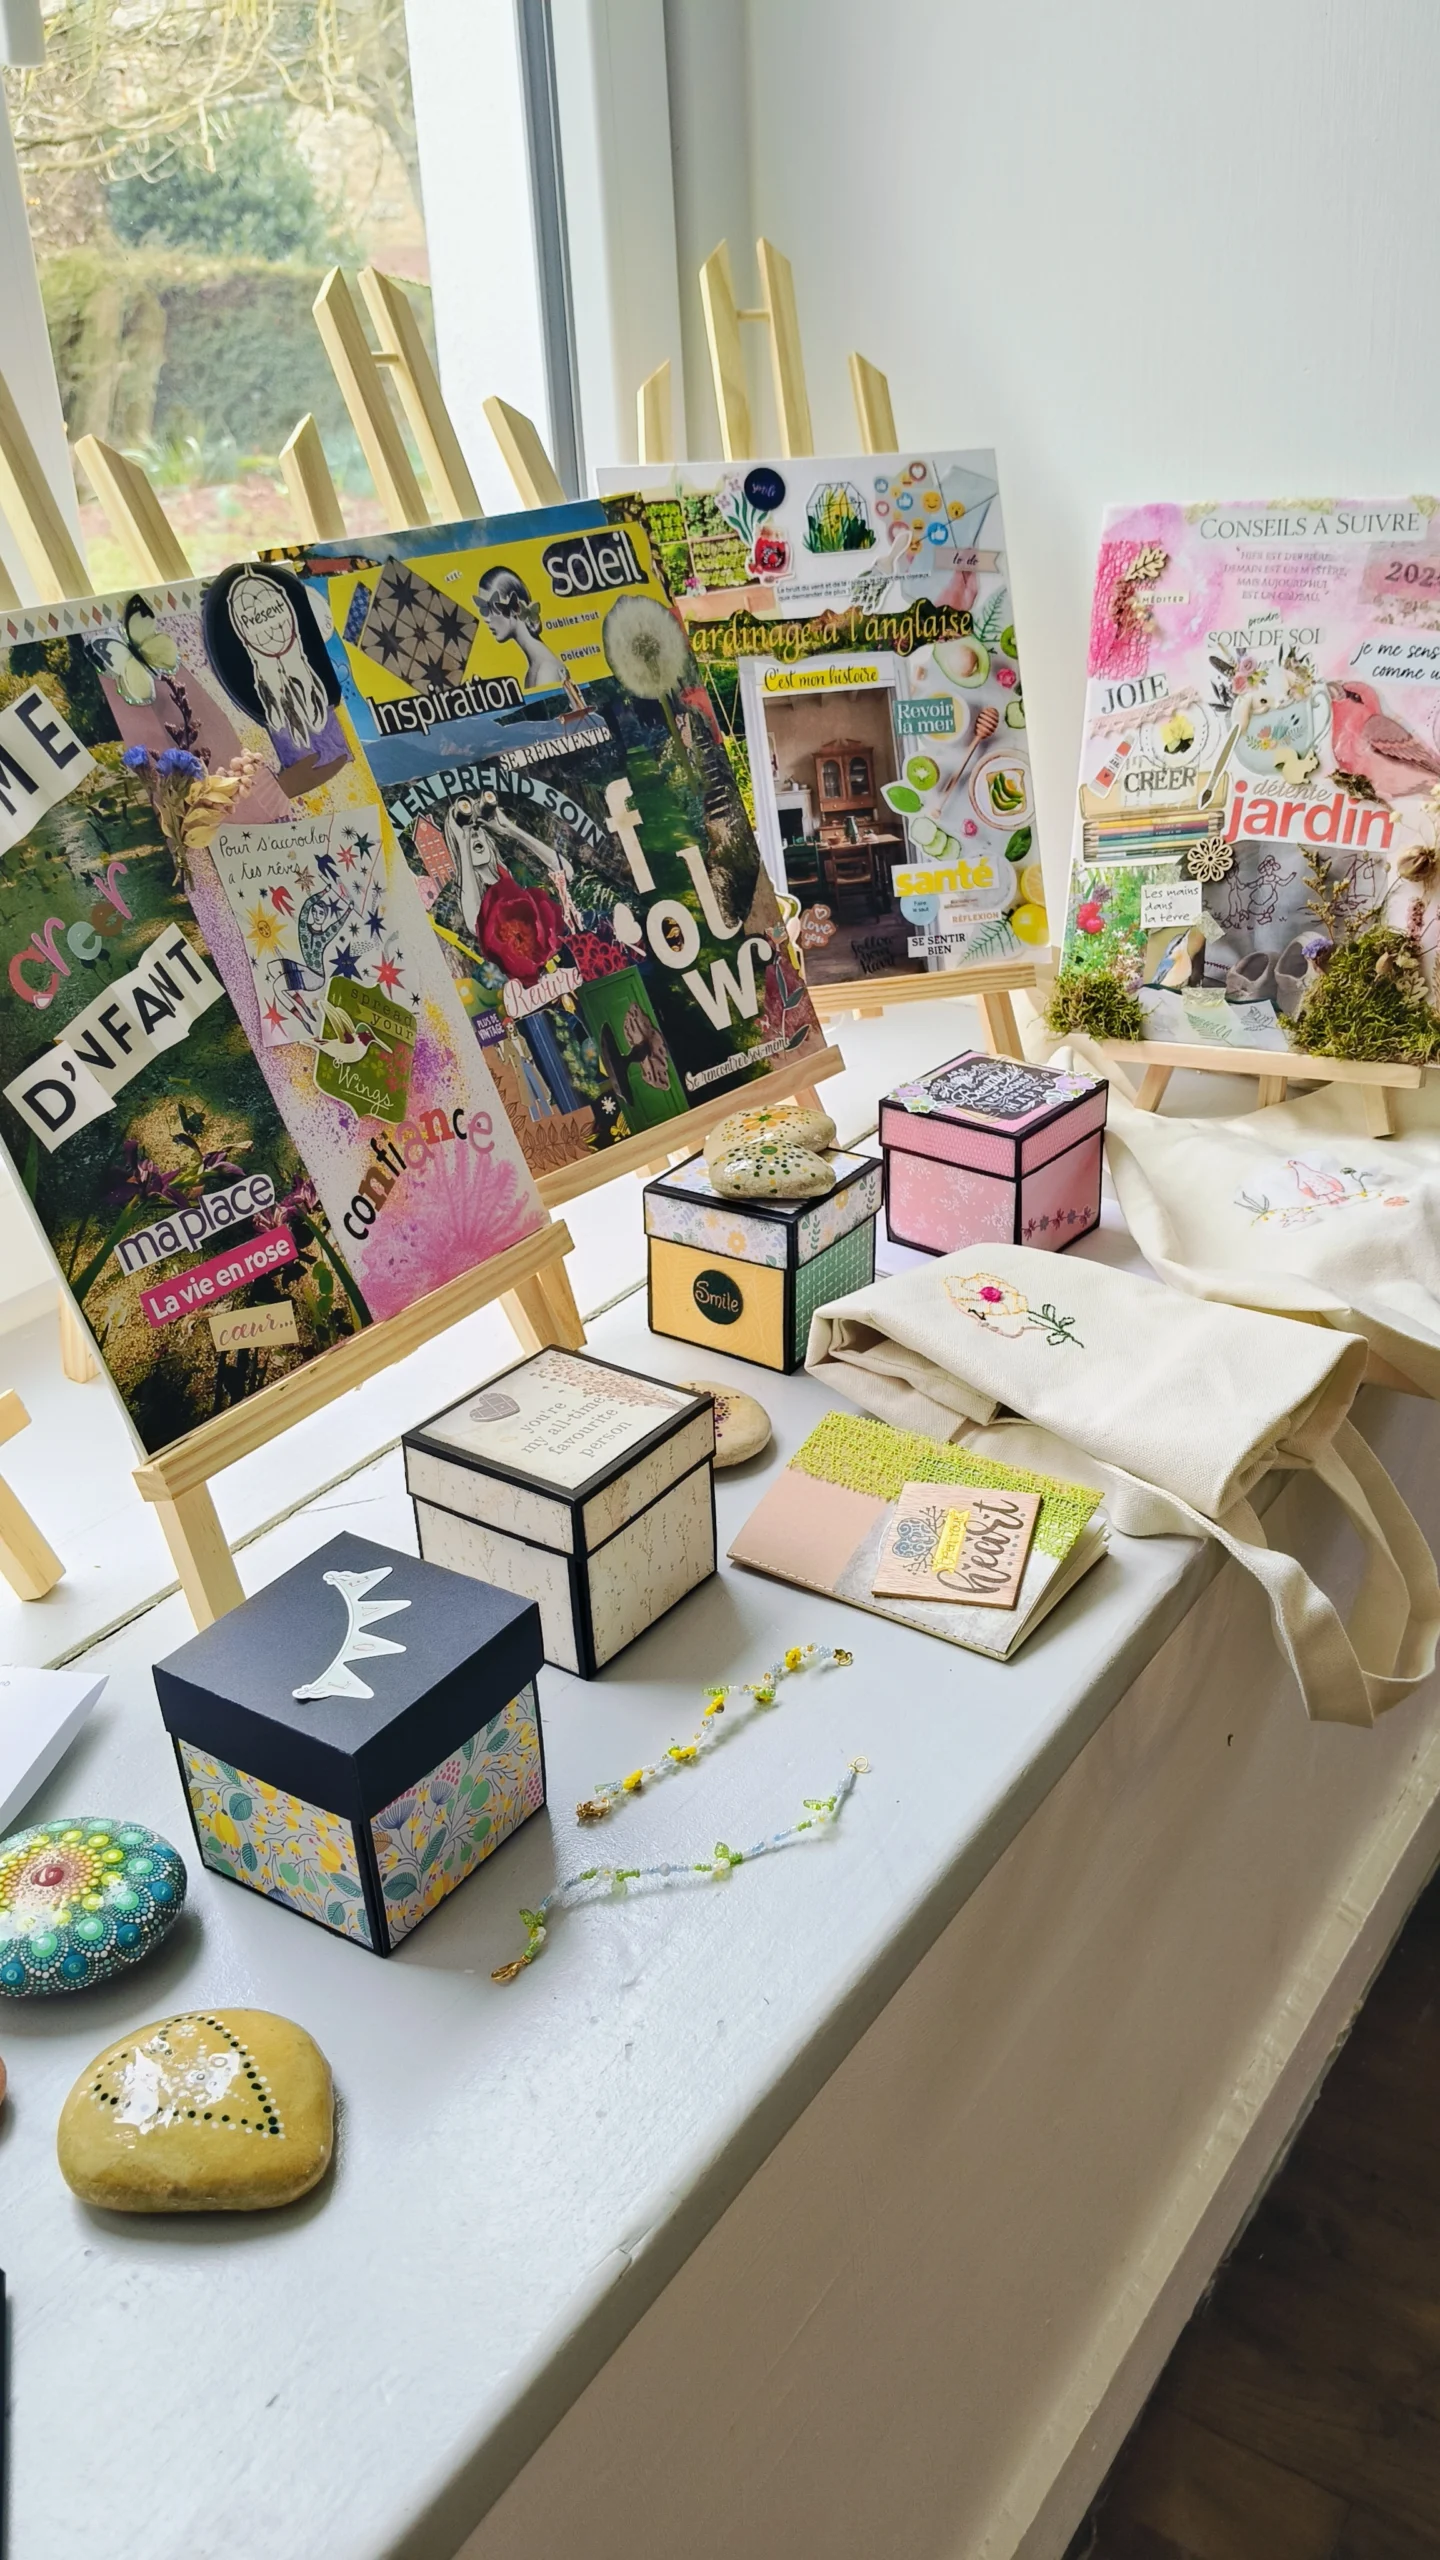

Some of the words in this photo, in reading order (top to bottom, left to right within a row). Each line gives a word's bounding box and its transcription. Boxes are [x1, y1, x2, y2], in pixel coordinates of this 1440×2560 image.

[1200, 517, 1307, 540] CONSEILS
[1336, 512, 1421, 535] SUIVRE
[547, 531, 643, 596] soleil
[1385, 561, 1440, 588] 202
[241, 599, 285, 630] Présent
[545, 616, 578, 632] Oubliez
[581, 610, 600, 622] tout
[851, 601, 973, 656] l'anglaise
[1289, 627, 1320, 645] SOI
[560, 643, 602, 662] DolceVita
[1350, 642, 1373, 666] je
[1378, 643, 1403, 657] me
[764, 667, 794, 691] C'est
[800, 674, 827, 687] mon
[830, 665, 878, 685] histoire
[1372, 665, 1425, 680] comme
[369, 676, 524, 738] Inspiration
[1101, 673, 1169, 714] JOIE
[897, 702, 954, 720] Revoir
[897, 720, 913, 734] la
[917, 718, 954, 733] mer
[1253, 778, 1335, 801] détente
[441, 766, 536, 798] PREND
[541, 788, 606, 848] SOIN
[1224, 780, 1396, 849] jardin
[219, 835, 251, 858] Pour
[257, 826, 331, 852] s'accrocher
[241, 861, 262, 880] tes
[267, 861, 302, 877] rêves
[896, 858, 993, 897] santé
[1144, 887, 1163, 899] Les
[1166, 885, 1200, 898] mains
[1144, 901, 1173, 911] dans
[952, 912, 999, 923] RÉFLEXION
[1144, 912, 1156, 923] la
[1160, 911, 1191, 922] terre
[912, 938, 925, 947] SE
[927, 933, 966, 946] SENTIR
[927, 945, 951, 956] BIEN
[350, 988, 413, 1028] spread
[476, 1017, 490, 1029] PLUS
[489, 1013, 499, 1024] DE
[370, 1012, 414, 1041] your
[477, 1023, 505, 1041] VINTAGE
[333, 1058, 394, 1116] Wings
[343, 1105, 494, 1241] confiance
[149, 1291, 181, 1320] La
[180, 1270, 215, 1306] vie
[216, 1259, 245, 1286] en
[243, 1237, 291, 1278] rose
[695, 1280, 739, 1313] Smile
[520, 1400, 567, 1434] you're
[521, 1436, 549, 1455] my
[549, 1395, 606, 1437] all-time
[549, 1407, 619, 1457] favourite
[579, 1421, 632, 1459] person
[937, 1499, 1024, 1594] heart
